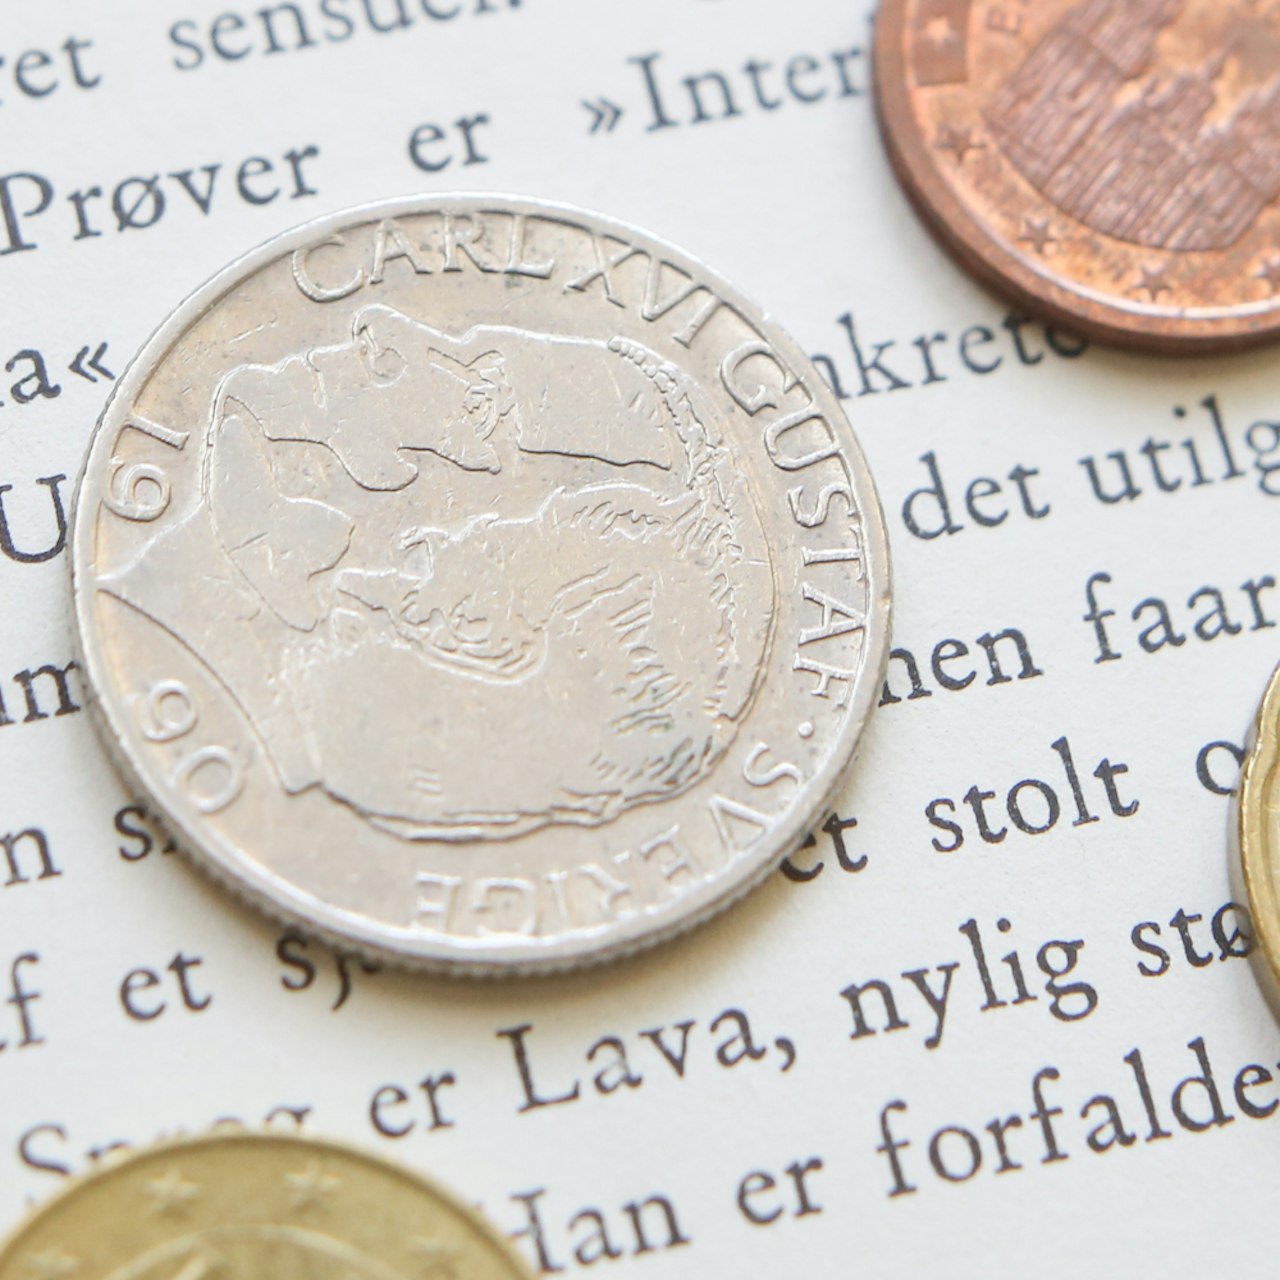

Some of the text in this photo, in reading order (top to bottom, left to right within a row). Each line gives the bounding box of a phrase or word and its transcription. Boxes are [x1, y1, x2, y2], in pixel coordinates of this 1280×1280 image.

[406, 113, 490, 174] er
[900, 451, 1051, 542] det
[291, 208, 875, 938] CARL XVI GUSTAF SVERIGE
[1082, 570, 1278, 664] faar
[924, 736, 1140, 853] stolt
[118, 953, 211, 1023] et
[368, 1072, 456, 1140] er
[495, 1003, 796, 1118] Lava,
[840, 917, 1099, 1051] nylig
[735, 1156, 824, 1227] er
